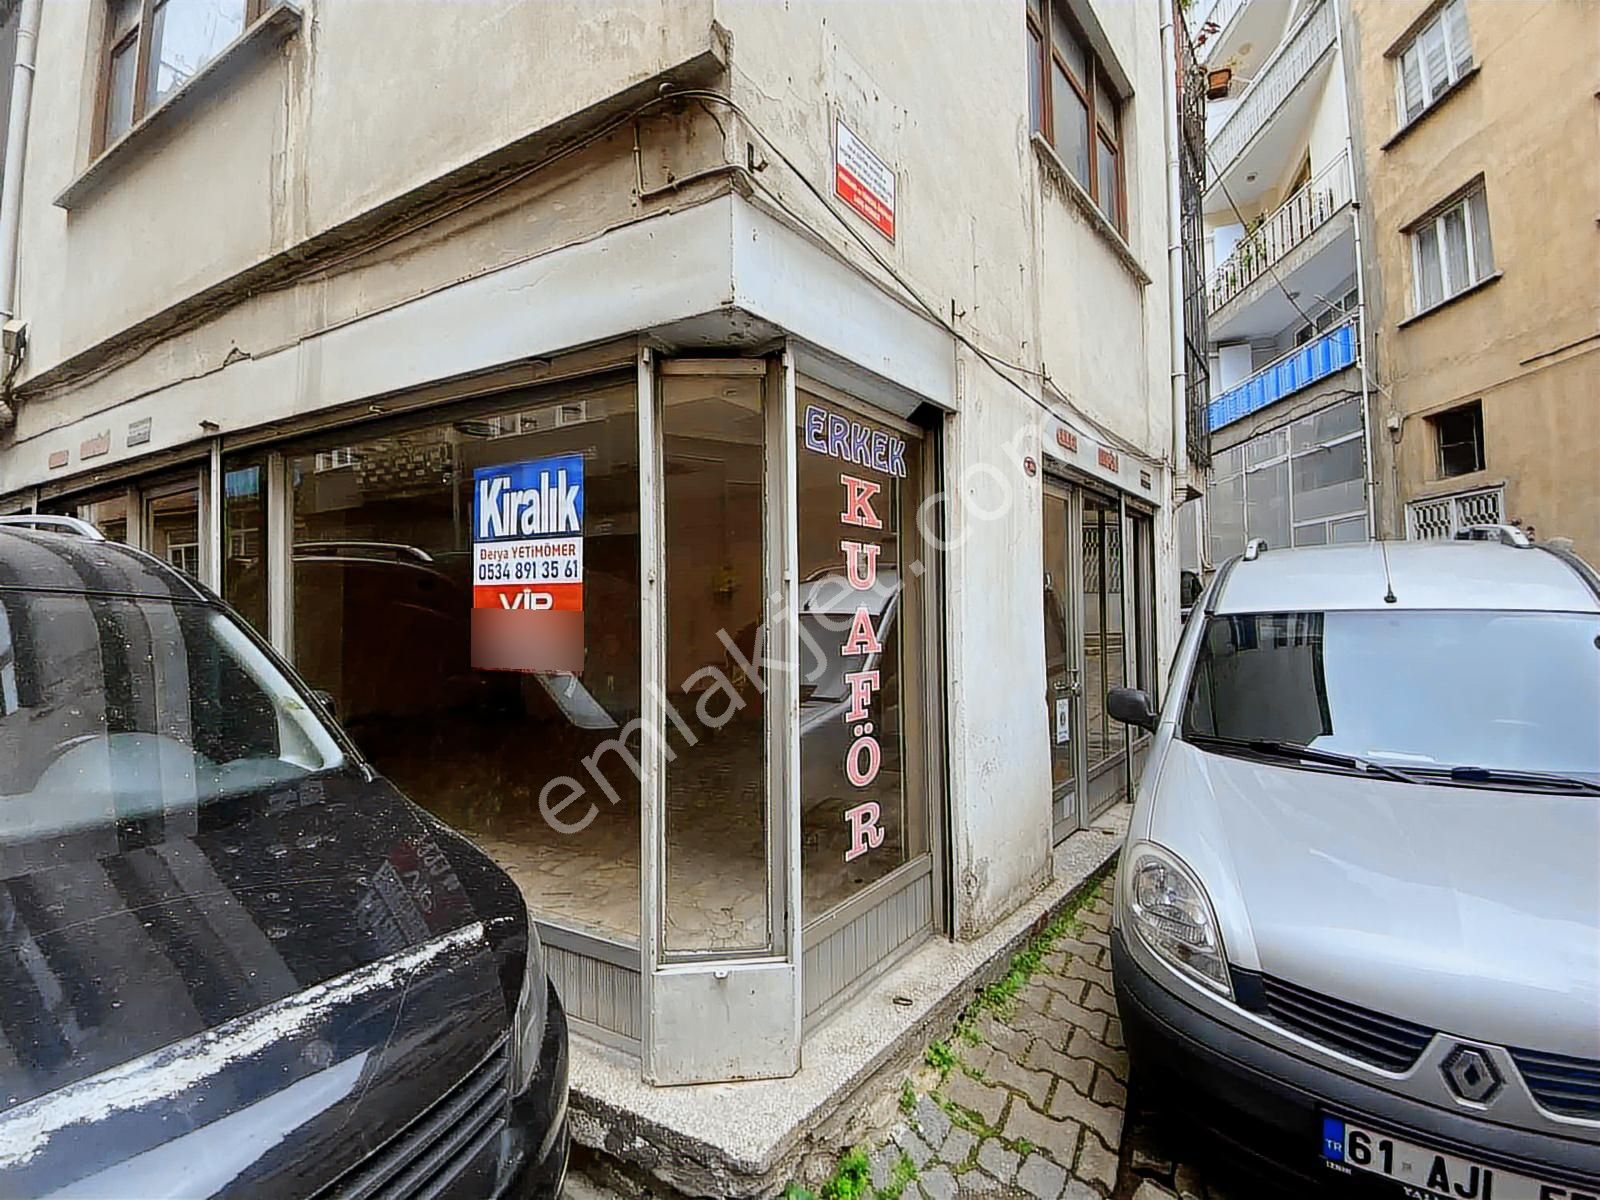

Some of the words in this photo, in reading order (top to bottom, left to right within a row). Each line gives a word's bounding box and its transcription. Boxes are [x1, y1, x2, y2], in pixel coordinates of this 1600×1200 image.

[804, 404, 907, 479] ERKEK
[479, 469, 581, 539] Kiralık
[479, 563, 510, 580] 0534
[515, 561, 536, 579] 891
[542, 560, 559, 578] 35
[564, 559, 578, 578] 61
[480, 548, 509, 562] Derya
[840, 474, 884, 863] KUAFÖR
[1348, 1130, 1394, 1175] 61
